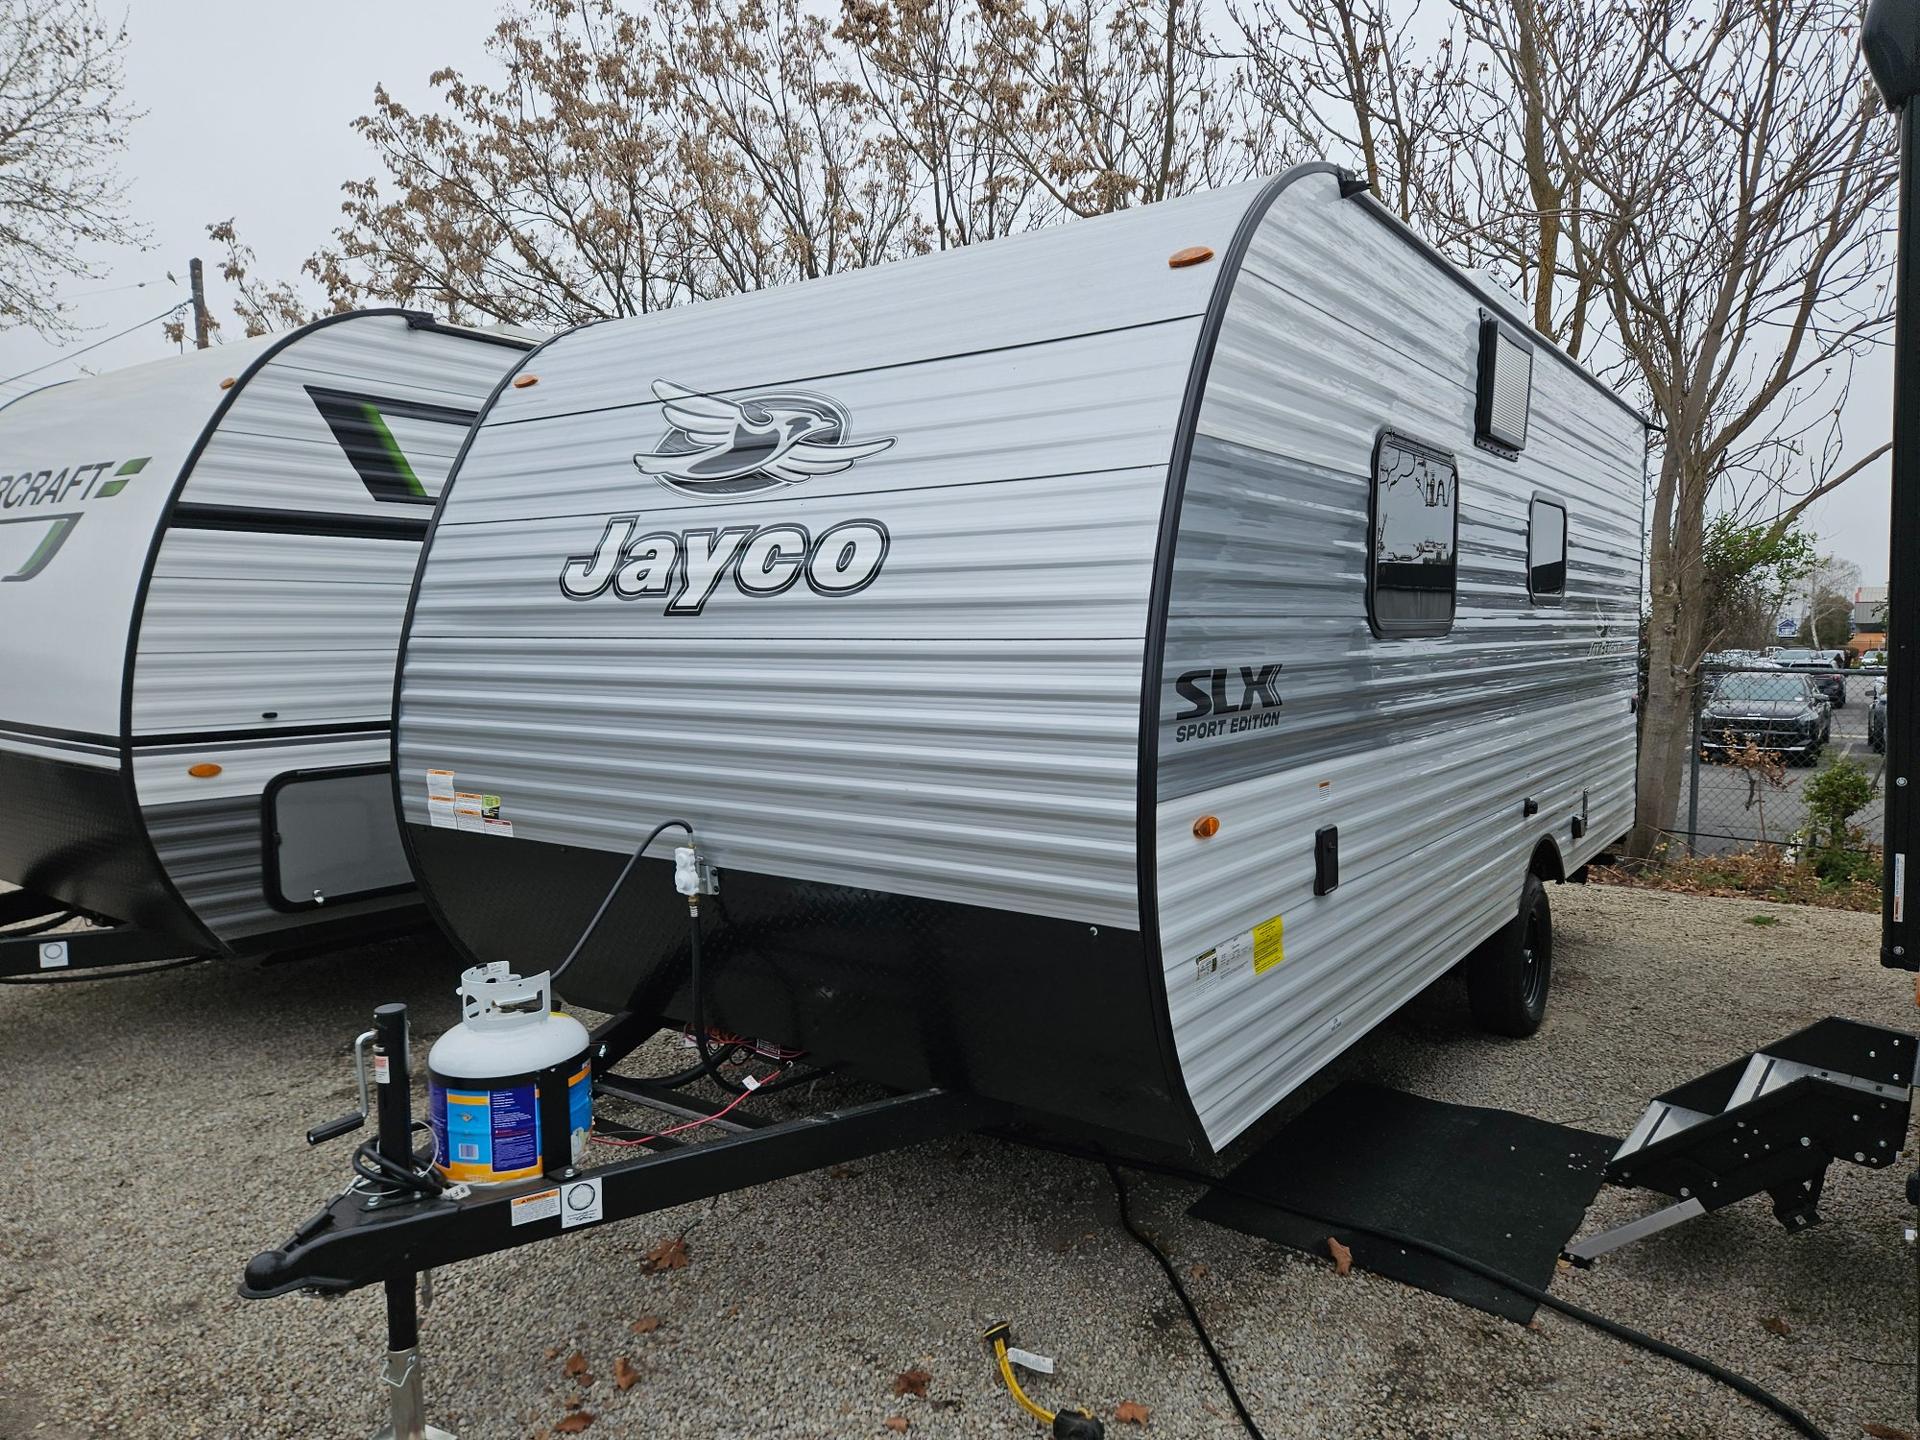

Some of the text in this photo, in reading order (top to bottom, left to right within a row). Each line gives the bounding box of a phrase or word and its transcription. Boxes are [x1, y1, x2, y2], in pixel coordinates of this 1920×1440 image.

[558, 514, 891, 617] Jayco
[1175, 664, 1283, 720] SLX
[1176, 712, 1281, 743] SPORT EDITION
